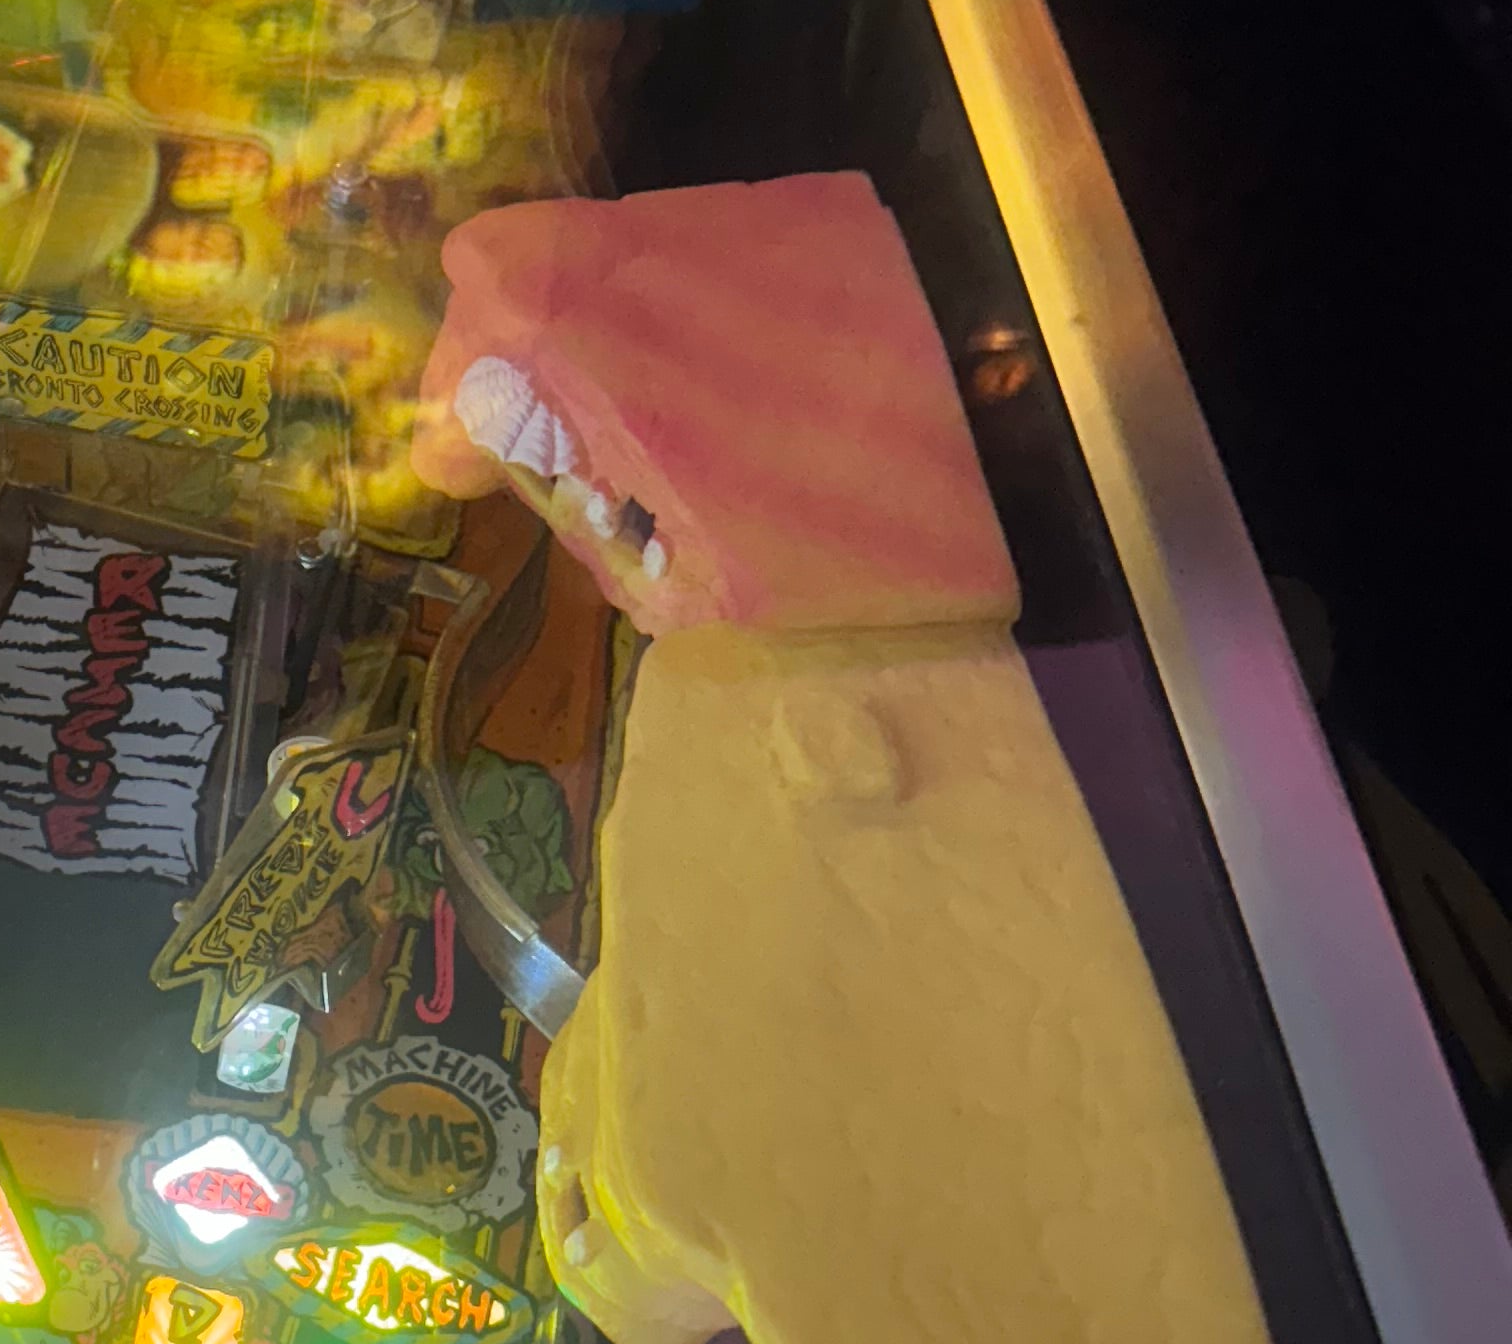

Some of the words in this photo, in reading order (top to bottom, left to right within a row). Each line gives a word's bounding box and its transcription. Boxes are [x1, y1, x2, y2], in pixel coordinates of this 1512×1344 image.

[113, 387, 261, 435] CROSSING
[41, 551, 172, 856] RESCUE
[346, 1042, 518, 1122] MACHINE
[289, 1242, 492, 1334] SEARCH
